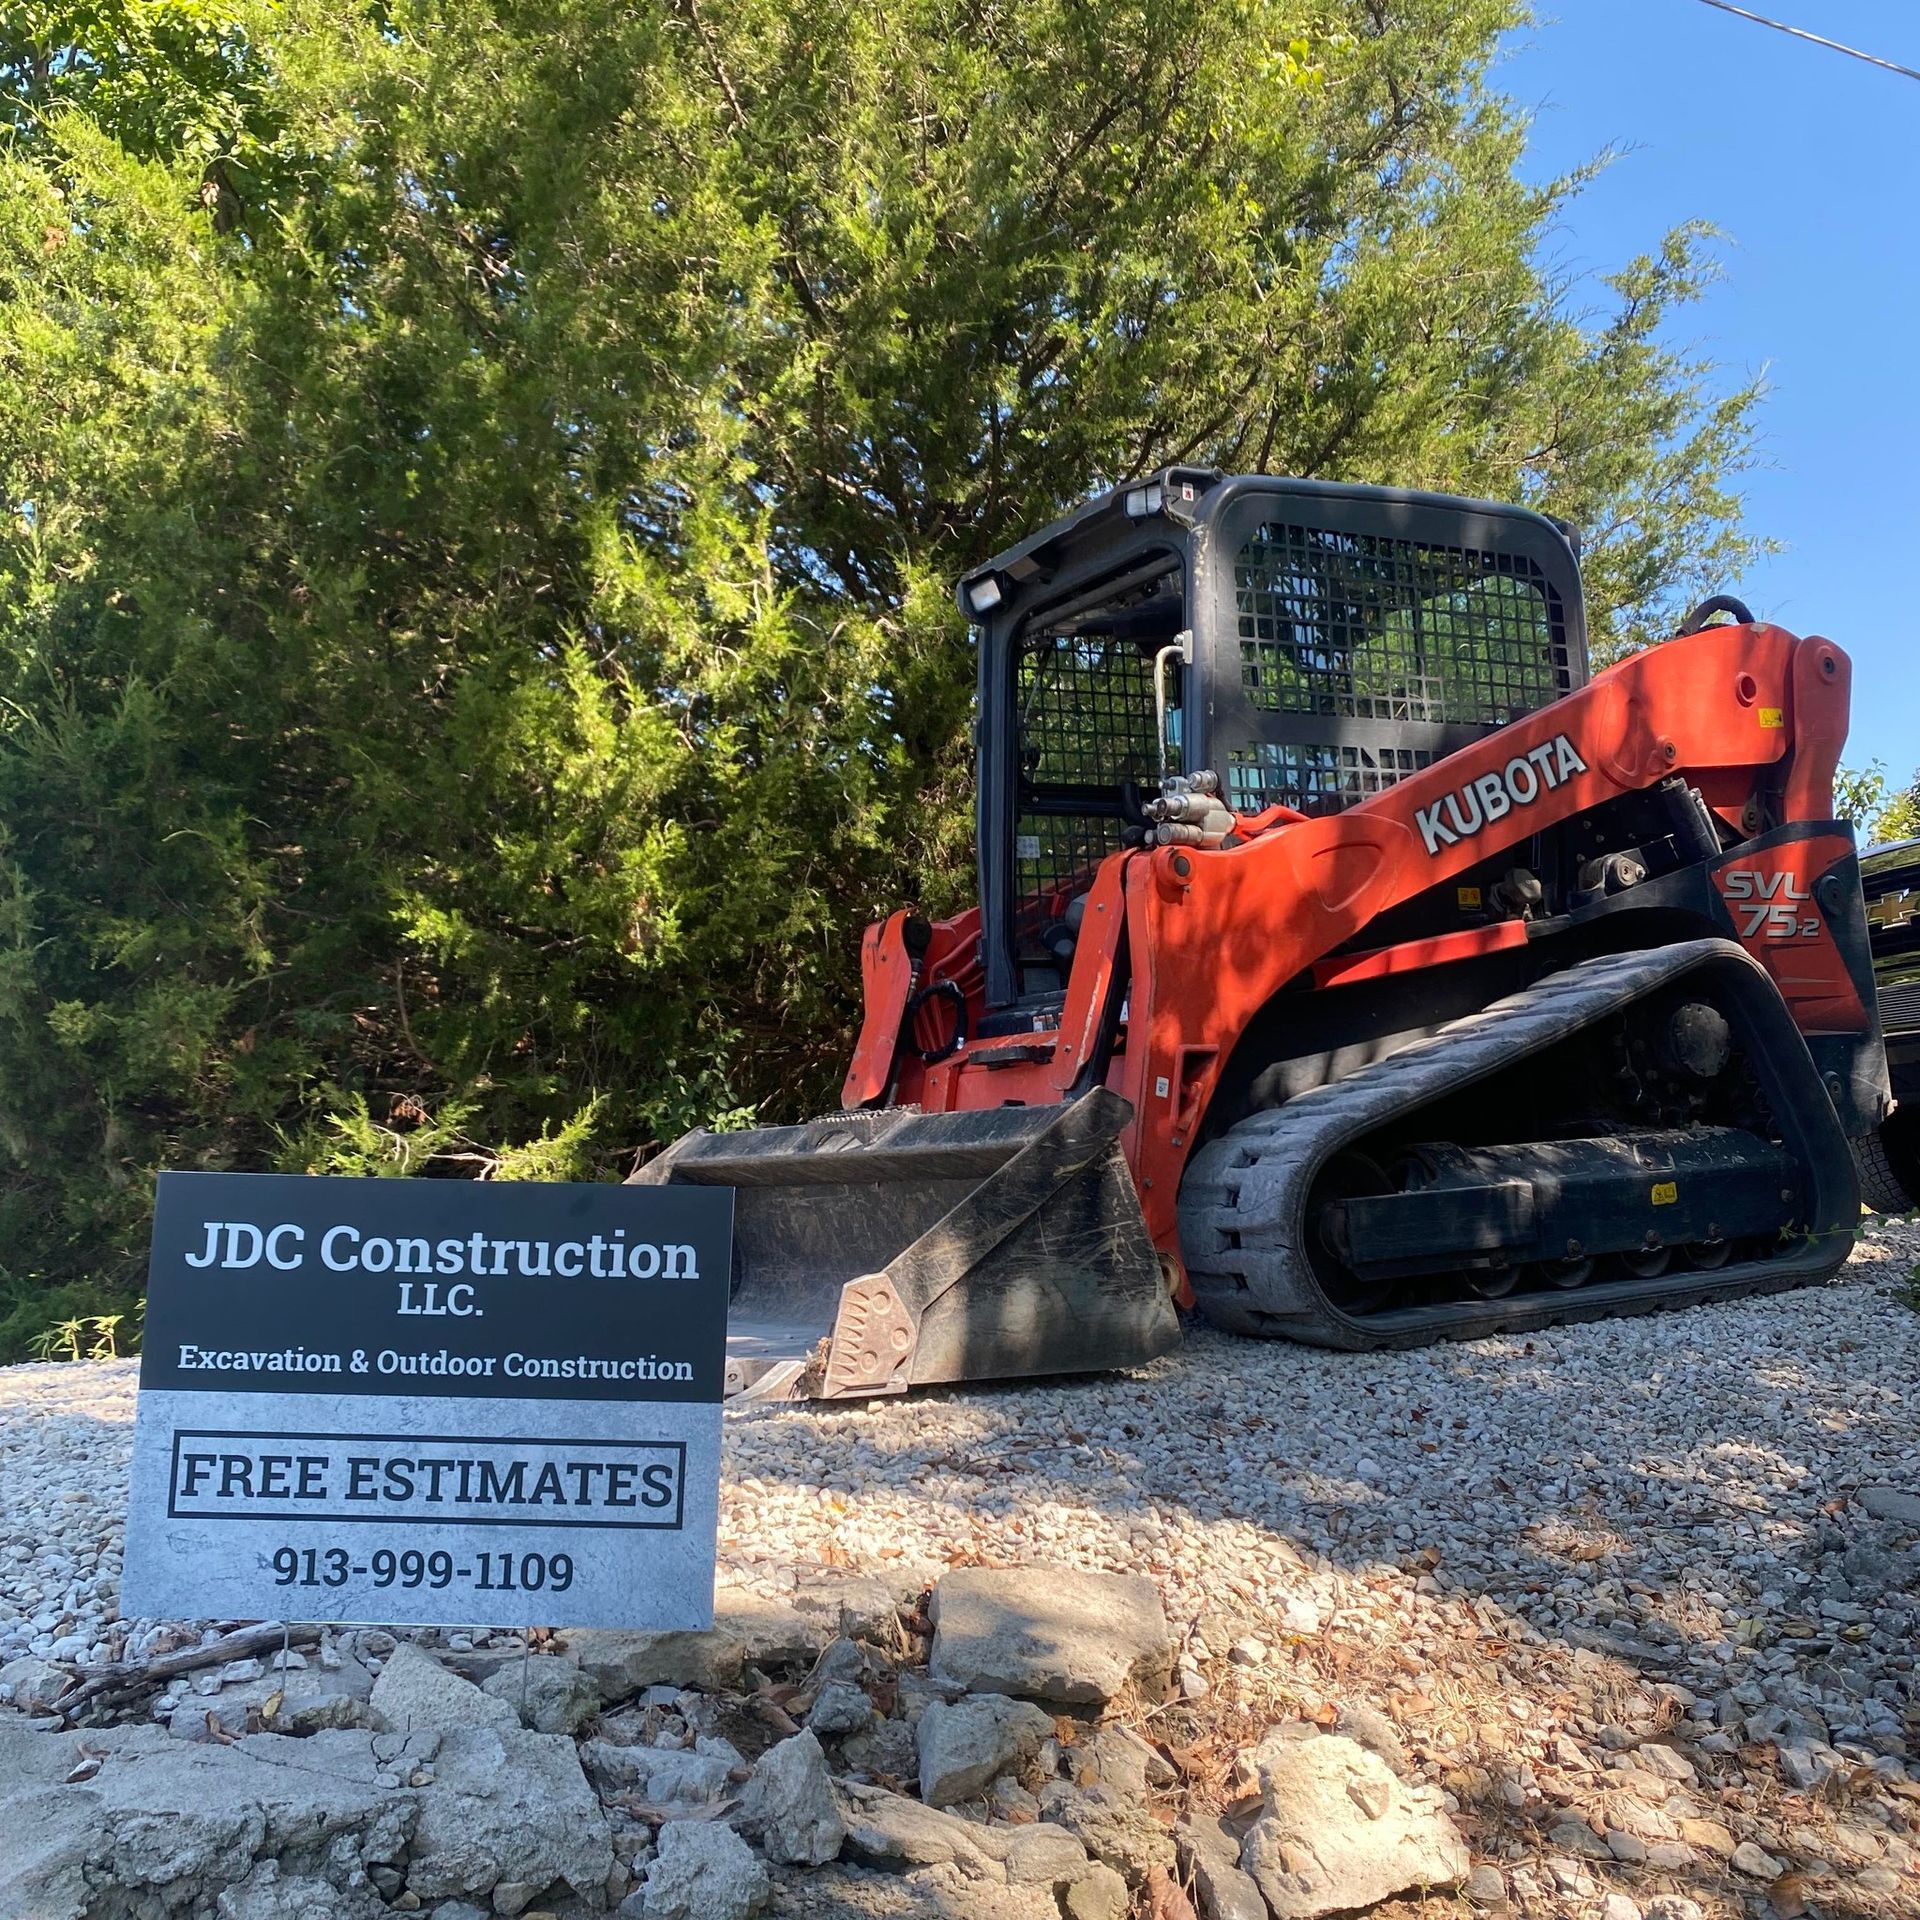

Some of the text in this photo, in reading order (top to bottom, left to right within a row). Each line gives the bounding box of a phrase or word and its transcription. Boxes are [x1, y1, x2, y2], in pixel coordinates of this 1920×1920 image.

[1414, 735, 1588, 856] KUBOTA
[1723, 870, 1810, 899] SVL
[184, 1222, 700, 1280] JDC Construction
[397, 1282, 484, 1317] LLC.
[177, 1344, 694, 1382] Excavation & Outdoor Construction
[180, 1453, 673, 1508] FREE ESTIMATES
[270, 1546, 574, 1593] 913-999-1109
